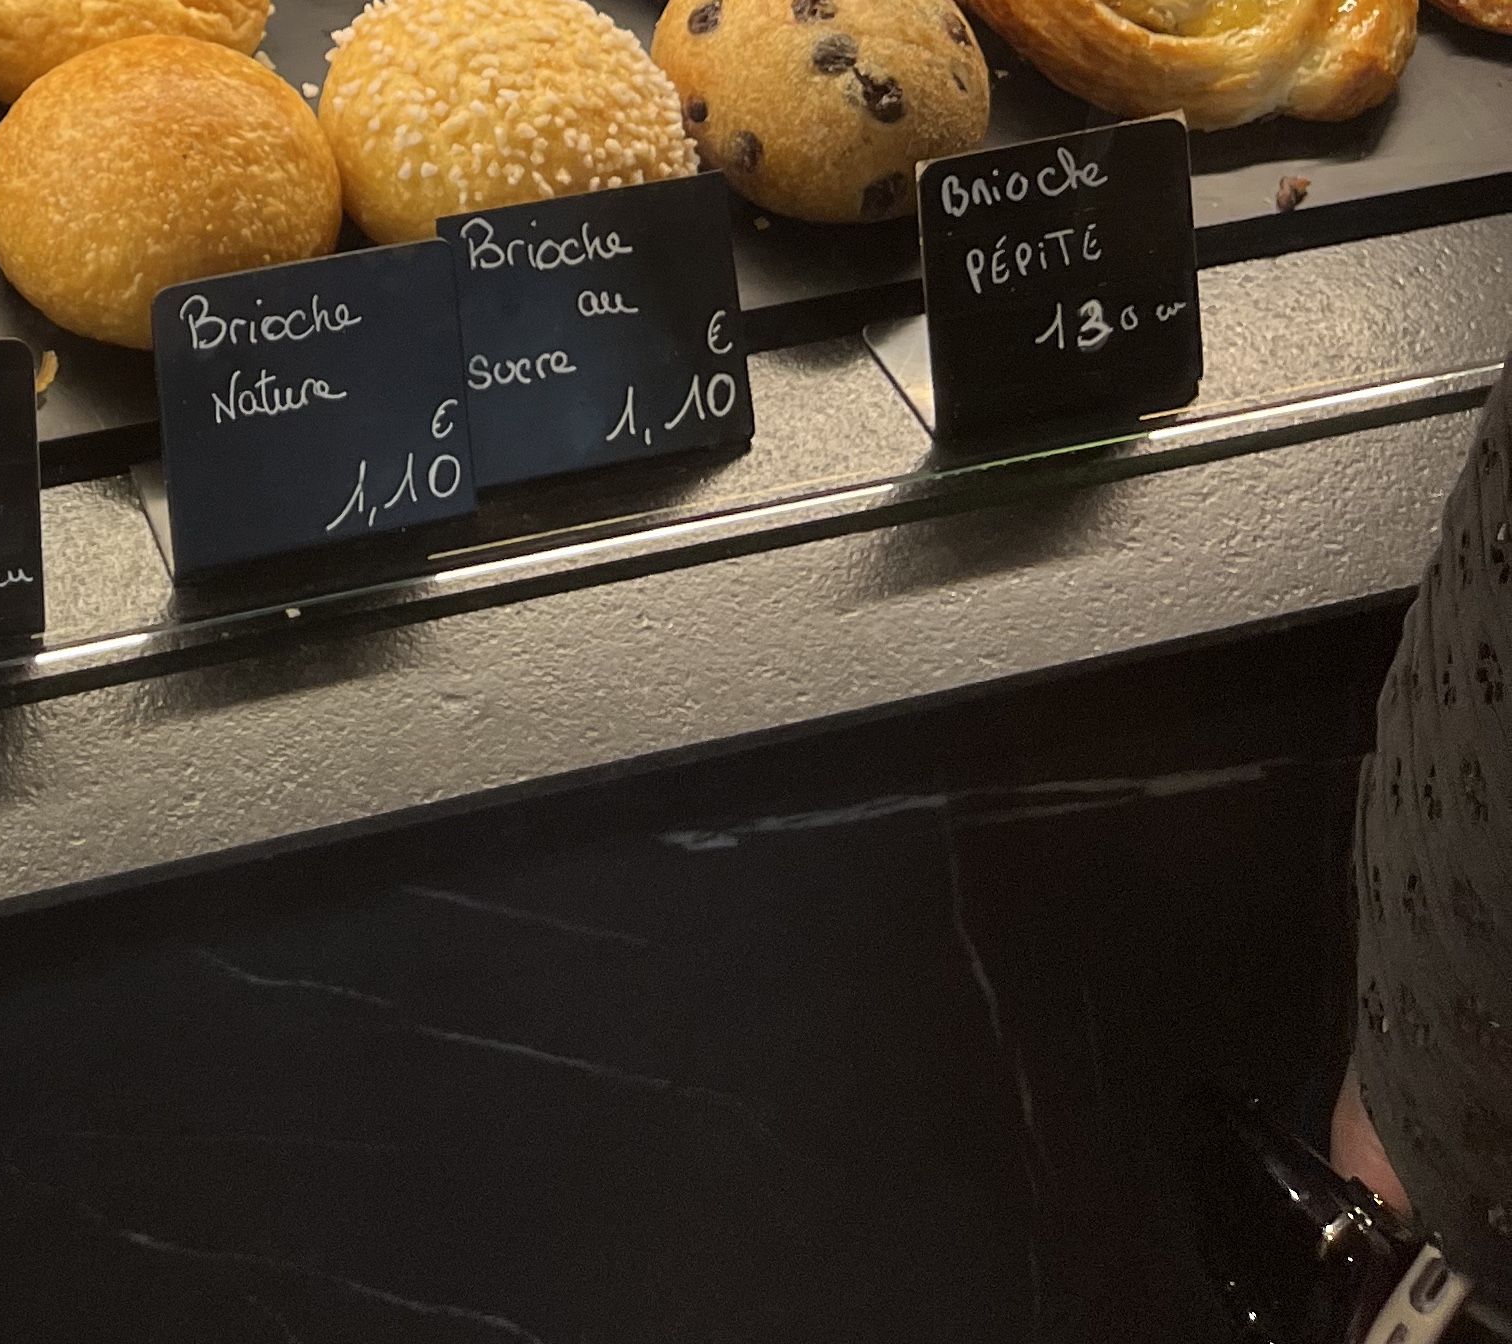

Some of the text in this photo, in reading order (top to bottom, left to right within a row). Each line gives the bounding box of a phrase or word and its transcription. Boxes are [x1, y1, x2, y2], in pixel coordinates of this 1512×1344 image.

[459, 215, 633, 272] Brioche
[178, 293, 362, 351] Brioche
[577, 288, 639, 316] au
[212, 368, 348, 424] Nature
